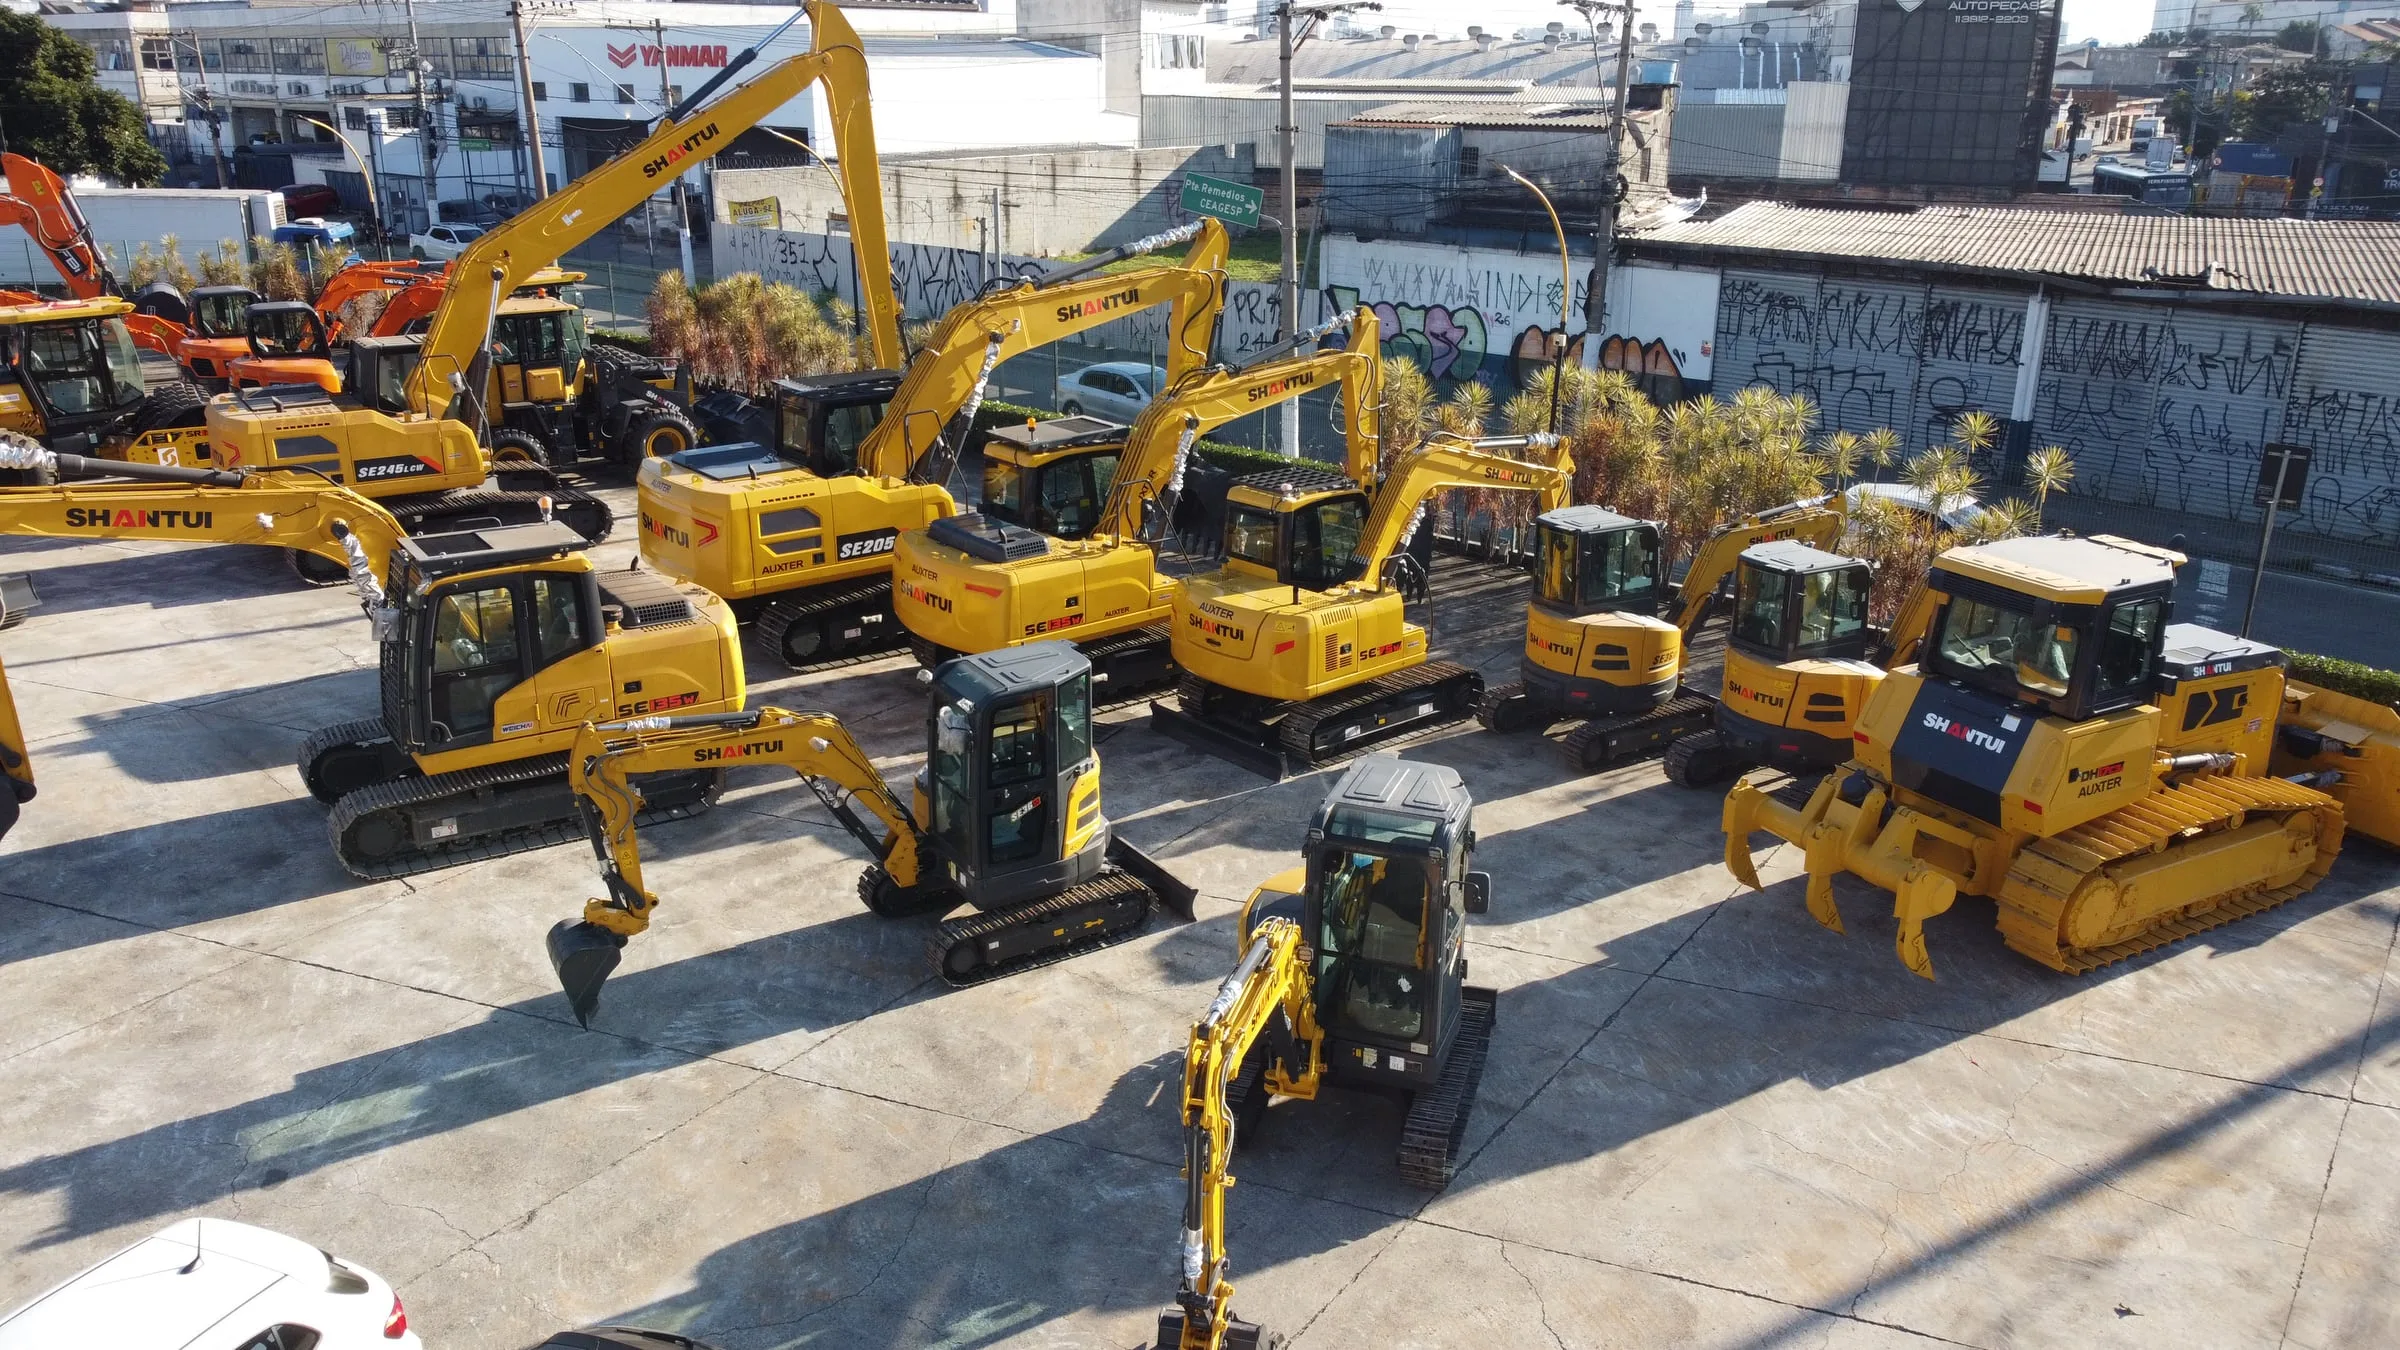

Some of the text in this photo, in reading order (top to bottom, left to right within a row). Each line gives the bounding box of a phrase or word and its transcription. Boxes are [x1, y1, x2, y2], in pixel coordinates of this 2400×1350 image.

[1948, 1, 2040, 13] AUTO PEÇAS
[640, 45, 728, 67] YANMAR
[642, 122, 719, 178] SHANTUI
[1201, 183, 1246, 202] Remedios
[1200, 198, 1243, 216] CEAGESP
[1057, 288, 1139, 323] SHANTUI
[1247, 370, 1314, 402] SHANTUI
[645, 390, 682, 413] SHANTUI
[1485, 466, 1533, 486] SHANTUI
[66, 507, 213, 530] SHANTUI
[642, 511, 690, 549] SHANTUI
[839, 534, 896, 560] SE205
[1749, 527, 1796, 545] SHANTUI
[762, 558, 804, 576] AUXTER
[911, 563, 938, 582] AUXTER
[900, 578, 953, 614] SHANTUI
[1104, 606, 1131, 618] AUXTER
[1199, 601, 1235, 621] AUXTER
[1189, 613, 1245, 642] SHANTUI
[1529, 632, 1574, 657] SHANTUI
[2192, 661, 2233, 678] SHANTUI
[618, 691, 700, 716] SE135W
[1728, 679, 1785, 709] SHANTUI
[501, 721, 534, 733] WEICHAI
[1922, 711, 2007, 755] SHANTUI
[693, 740, 784, 763] SHANTUI
[2077, 776, 2122, 799] AUXTER
